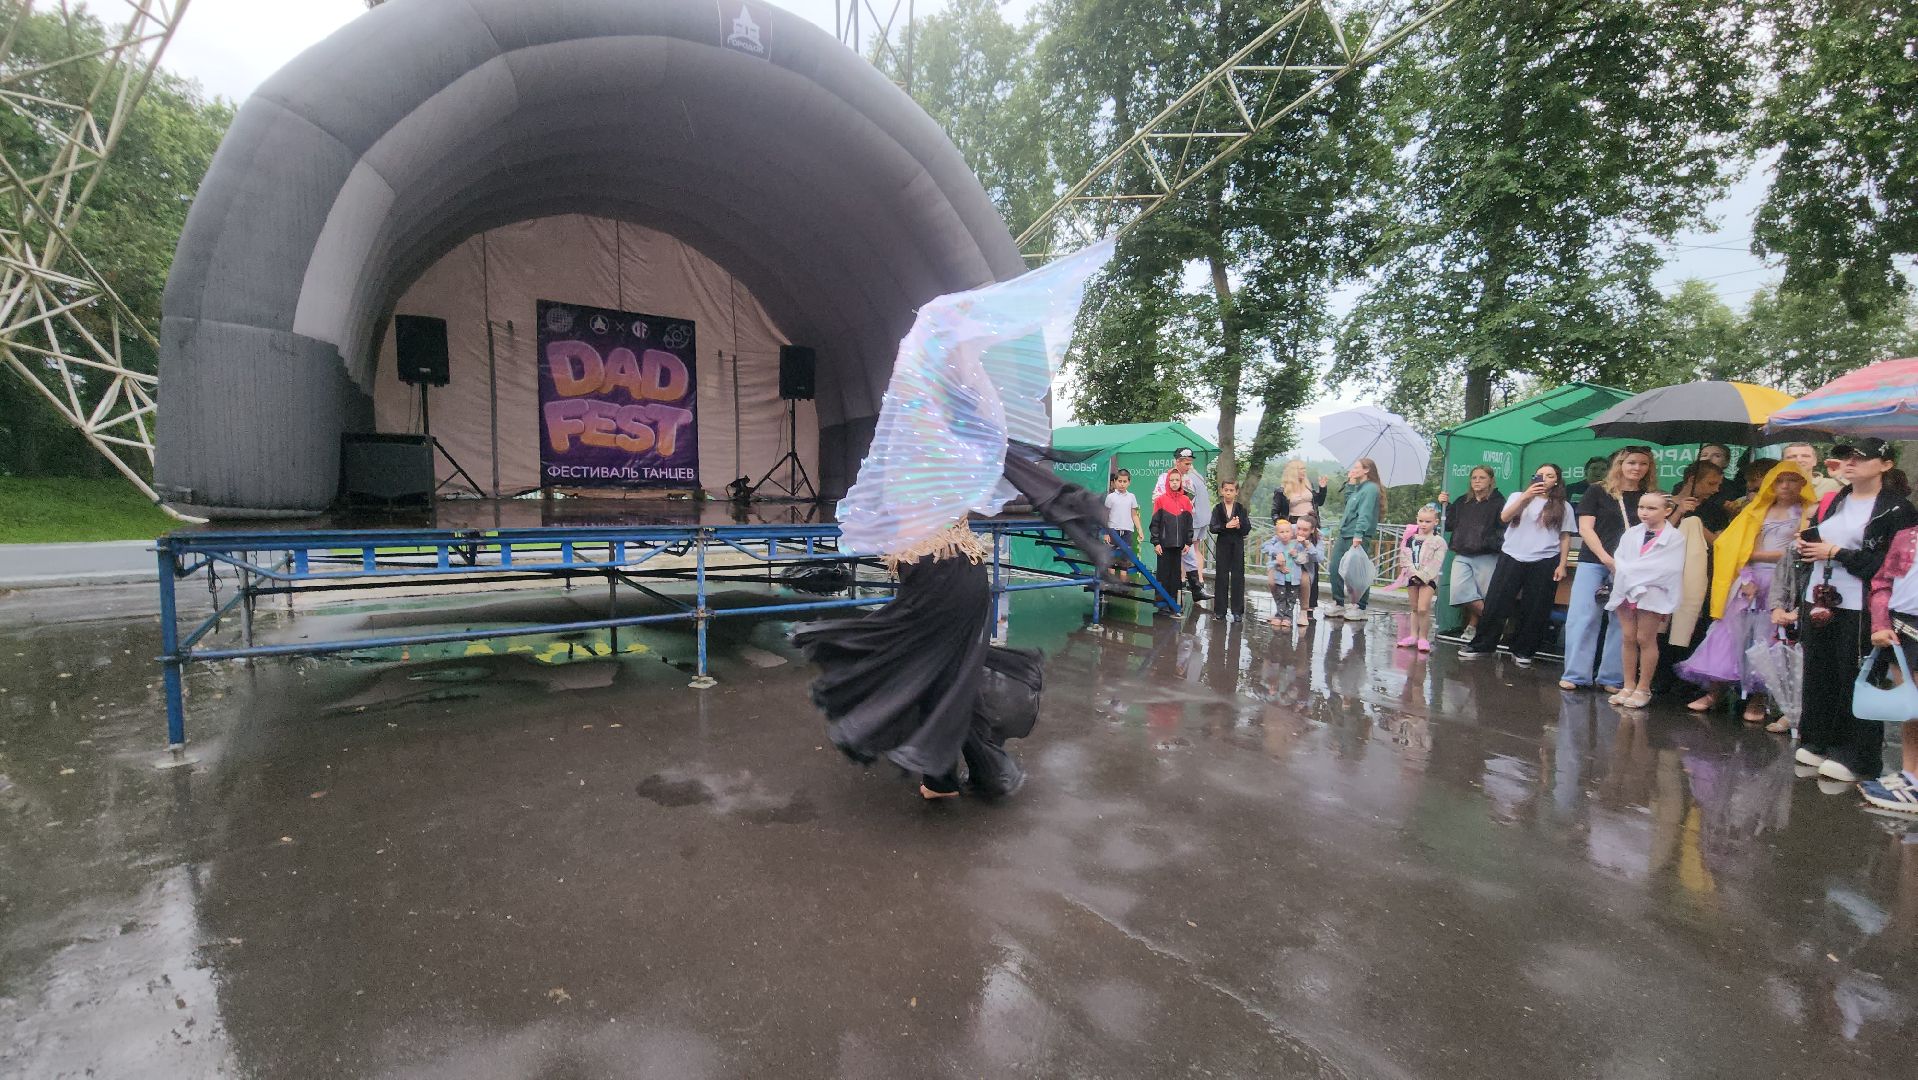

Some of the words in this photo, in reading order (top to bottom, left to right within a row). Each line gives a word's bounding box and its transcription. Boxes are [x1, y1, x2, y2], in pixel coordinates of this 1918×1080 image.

[546, 340, 689, 401] DAD
[543, 398, 693, 457] FEST
[547, 466, 639, 479] ФЕСТИВАЛЬ
[642, 467, 694, 480] ТАНЦЕВ
